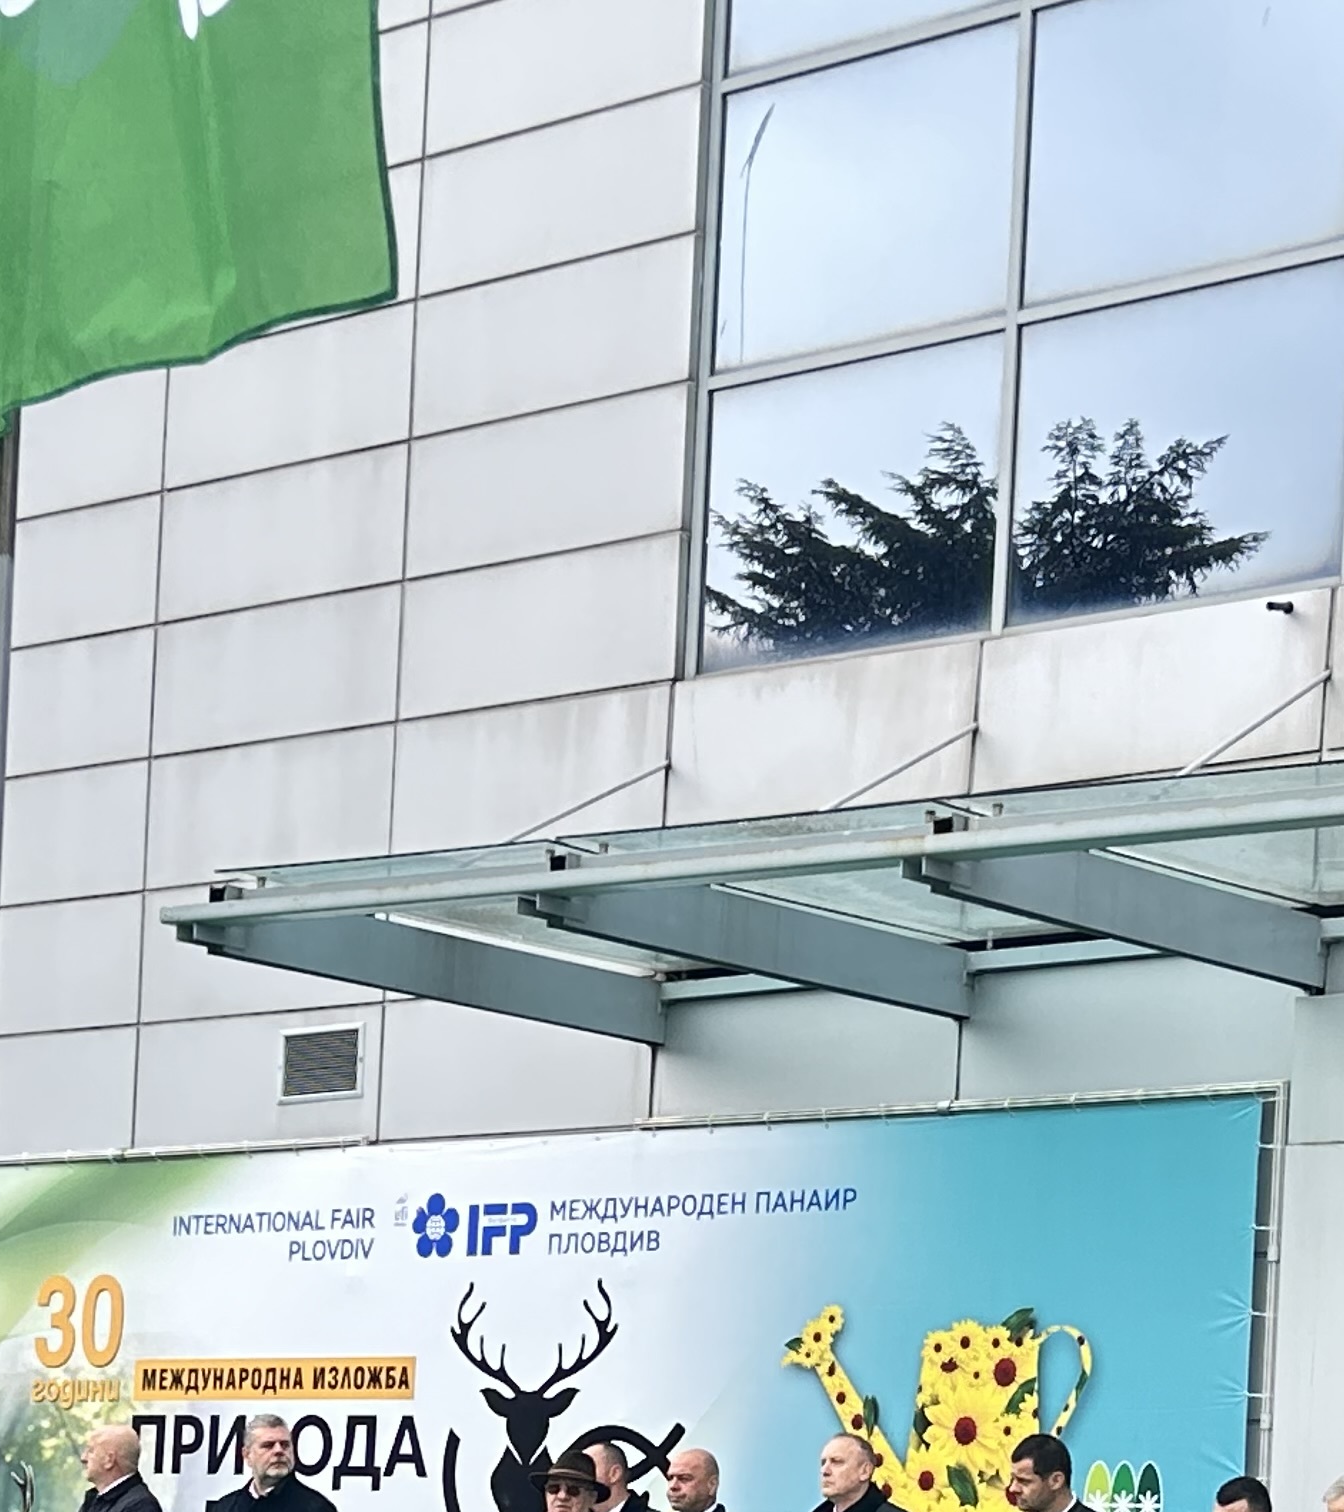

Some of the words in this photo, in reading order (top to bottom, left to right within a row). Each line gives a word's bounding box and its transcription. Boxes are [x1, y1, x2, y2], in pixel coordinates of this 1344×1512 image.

[549, 1192, 747, 1224] МЕЖДУНАРОДЕН
[754, 1187, 857, 1215] ПАНАИР
[172, 1208, 326, 1237] INTERNATIONAL
[330, 1207, 376, 1231] FAIR
[466, 1202, 538, 1257] IFP
[288, 1238, 375, 1263] PLOVDIV
[548, 1230, 660, 1258] ПЛОВДИВ
[34, 1274, 124, 1368] 30
[31, 1377, 120, 1409] години
[141, 1367, 304, 1395] МЕЖДУНАРОДНА
[312, 1365, 410, 1391] ИЗЛОЖБА
[132, 1414, 428, 1491] ПРИОДА
